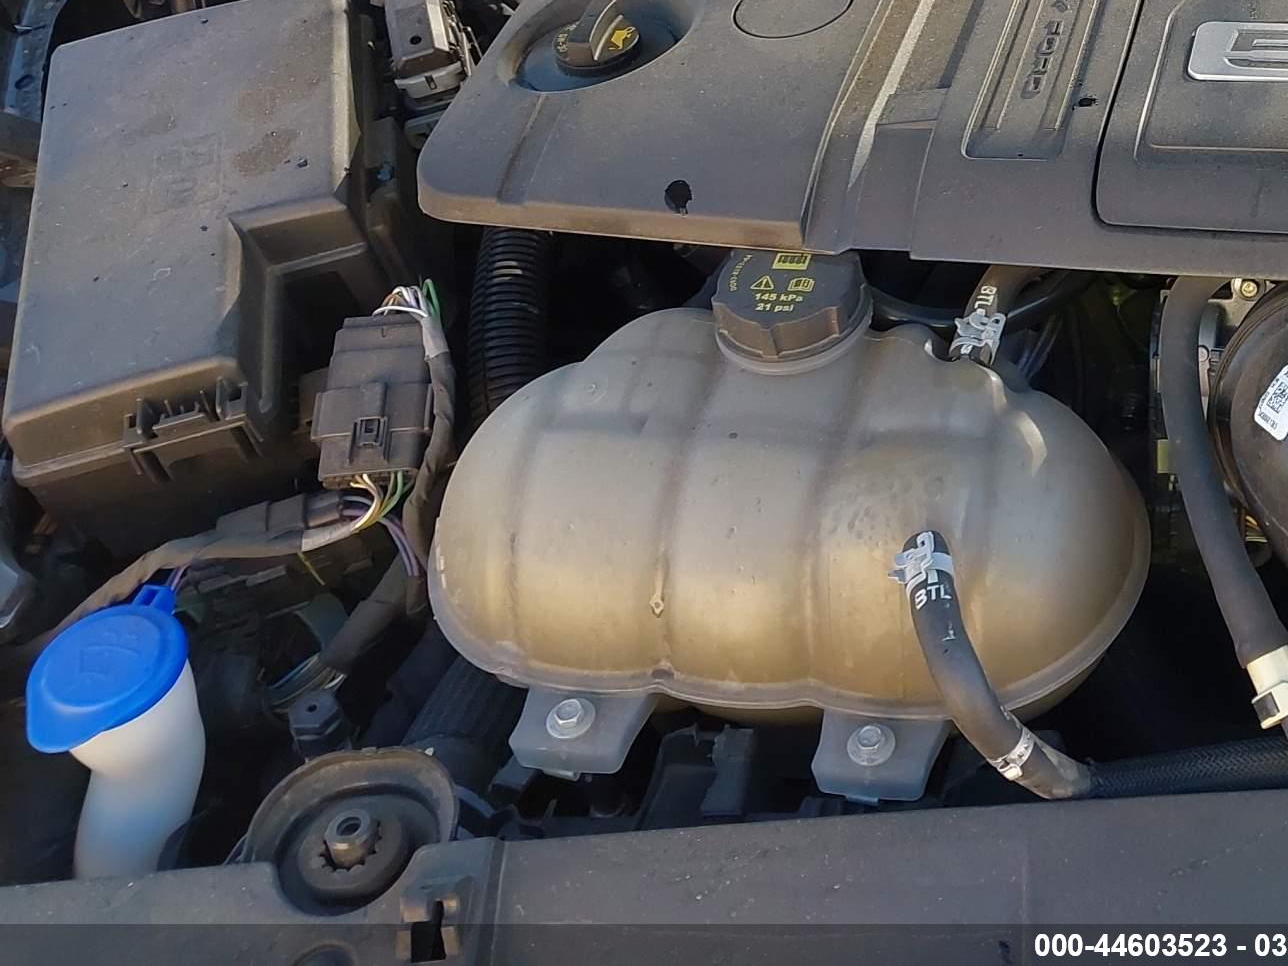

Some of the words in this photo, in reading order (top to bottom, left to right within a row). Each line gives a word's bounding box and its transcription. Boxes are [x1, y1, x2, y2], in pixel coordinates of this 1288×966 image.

[1020, 20, 1064, 100] FORD
[754, 292, 777, 302] 145
[779, 292, 804, 303] kPa
[754, 302, 771, 312] 21
[773, 303, 795, 314] psi
[974, 285, 998, 309] BTL
[914, 584, 953, 610] BTL
